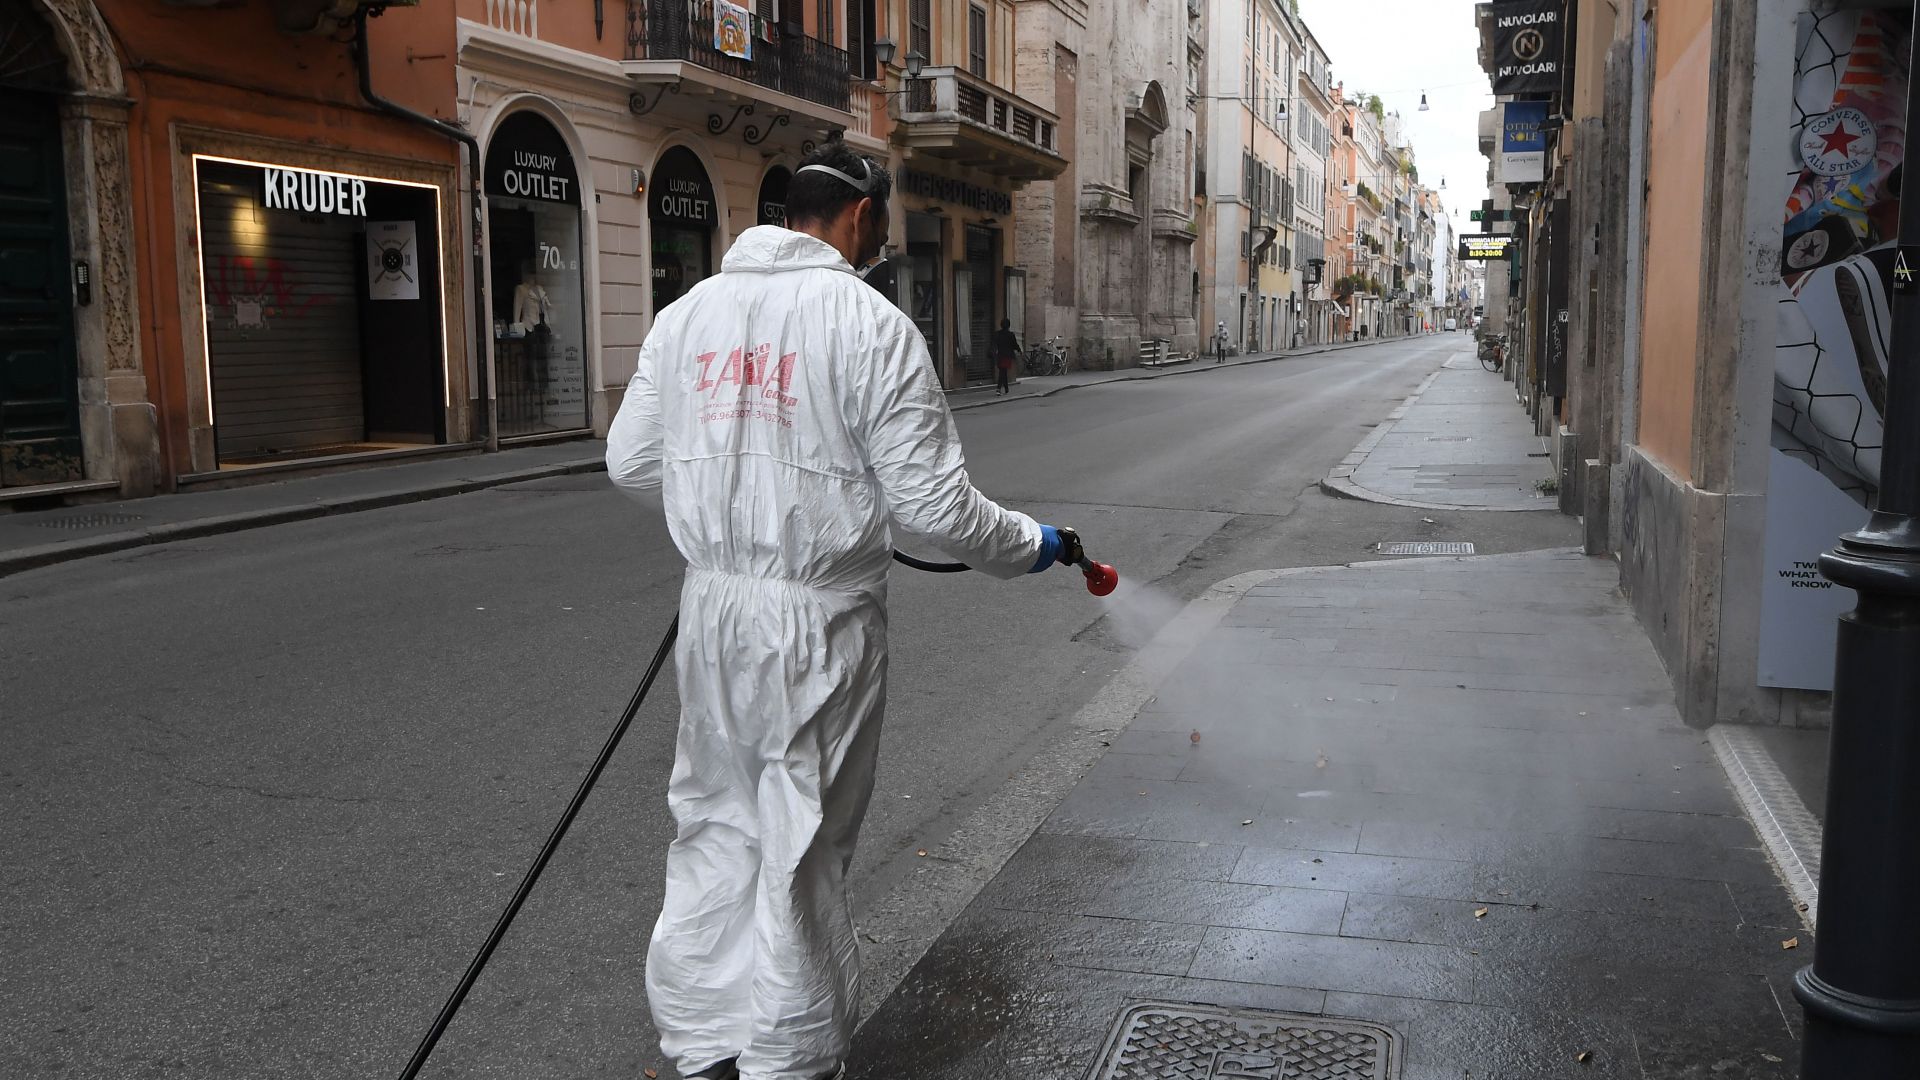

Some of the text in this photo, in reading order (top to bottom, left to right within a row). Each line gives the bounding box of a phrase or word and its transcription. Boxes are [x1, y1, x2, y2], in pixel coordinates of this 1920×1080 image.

[1498, 10, 1557, 28] NUVOLARI
[1498, 61, 1556, 78] NUVOLARI
[1811, 110, 1871, 136] CONVERSE
[514, 150, 557, 172] LUXURY
[1807, 153, 1861, 172] ALL STAR
[264, 167, 367, 217] KRUDER
[503, 169, 569, 201] OUTLET
[669, 178, 701, 196] LUXURY
[661, 195, 709, 221] OUTLET
[1793, 561, 1817, 569] TWI
[1779, 570, 1818, 579] WHAT
[1791, 580, 1833, 589] KNOW
